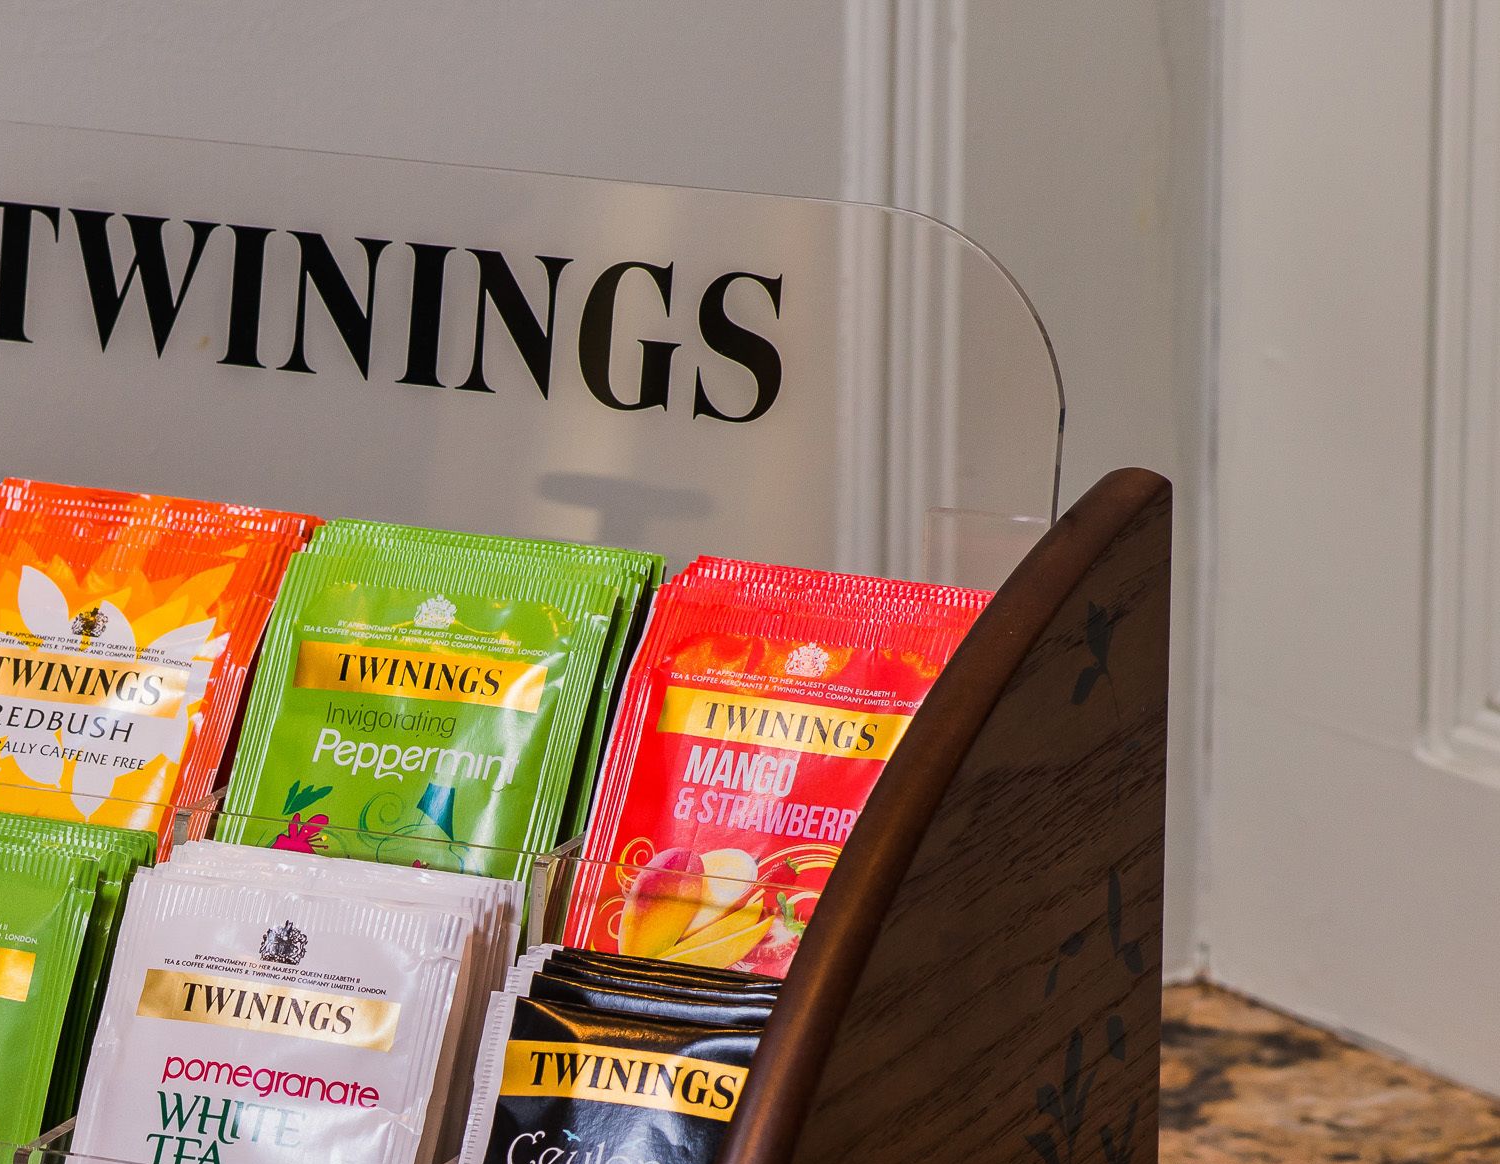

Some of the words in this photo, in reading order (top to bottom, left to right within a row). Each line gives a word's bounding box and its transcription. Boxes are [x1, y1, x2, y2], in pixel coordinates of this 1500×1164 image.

[338, 653, 503, 698] TWININGS
[715, 669, 767, 682] APPOINTMENT
[779, 677, 794, 685] HER
[795, 679, 826, 690] MAJESTY
[827, 683, 853, 694] QUEEN
[854, 687, 889, 697] ELIZABETH
[326, 701, 457, 738] Invigorating
[705, 701, 878, 752] TWININGS
[40, 744, 107, 767] CAFFEINE
[112, 755, 145, 771] FREE
[311, 728, 520, 785] Peppermint
[682, 746, 798, 798] MANGO
[673, 788, 695, 820] &
[697, 790, 859, 842] STRAWBERR
[182, 981, 355, 1035] TWININGS
[161, 1055, 380, 1109] pomegranate
[530, 1051, 738, 1110] TWININGS
[156, 1090, 306, 1149] WHITE
